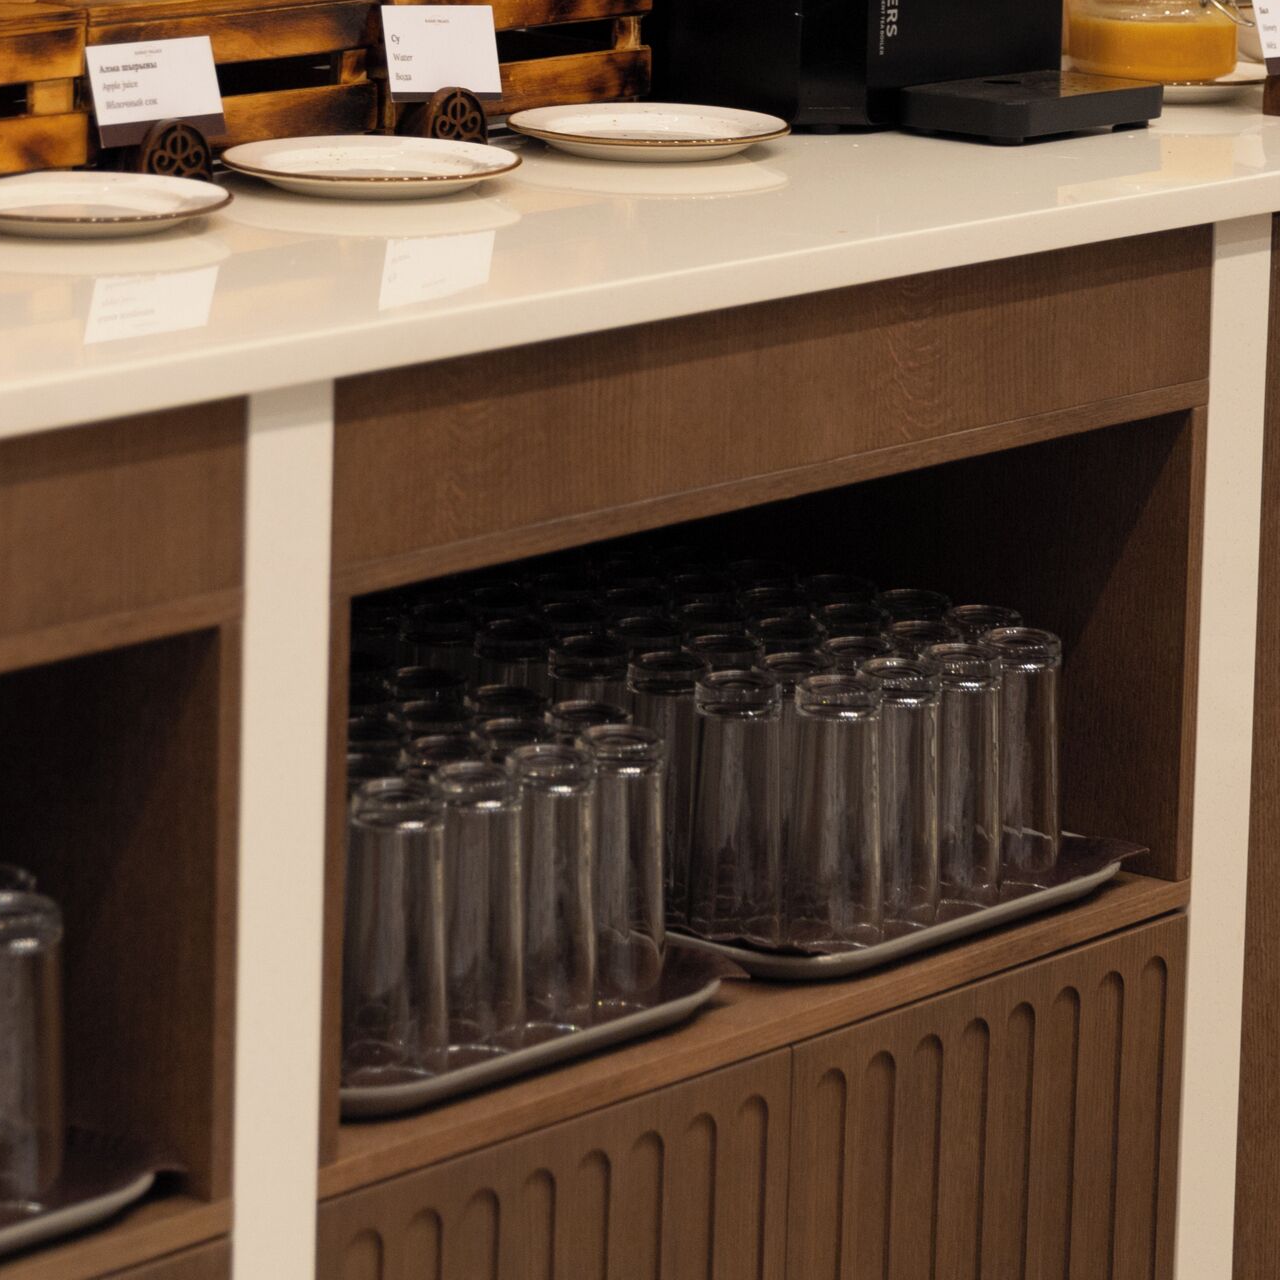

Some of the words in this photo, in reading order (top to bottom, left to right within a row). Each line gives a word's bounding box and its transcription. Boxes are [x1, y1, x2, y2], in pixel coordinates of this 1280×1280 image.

[393, 52, 413, 61] Water
[99, 64, 120, 73] Алма
[122, 61, 157, 72] шырыны
[395, 72, 412, 81] Вода
[103, 81, 121, 92] Apple
[122, 80, 138, 91] juice
[145, 98, 158, 106] сок
